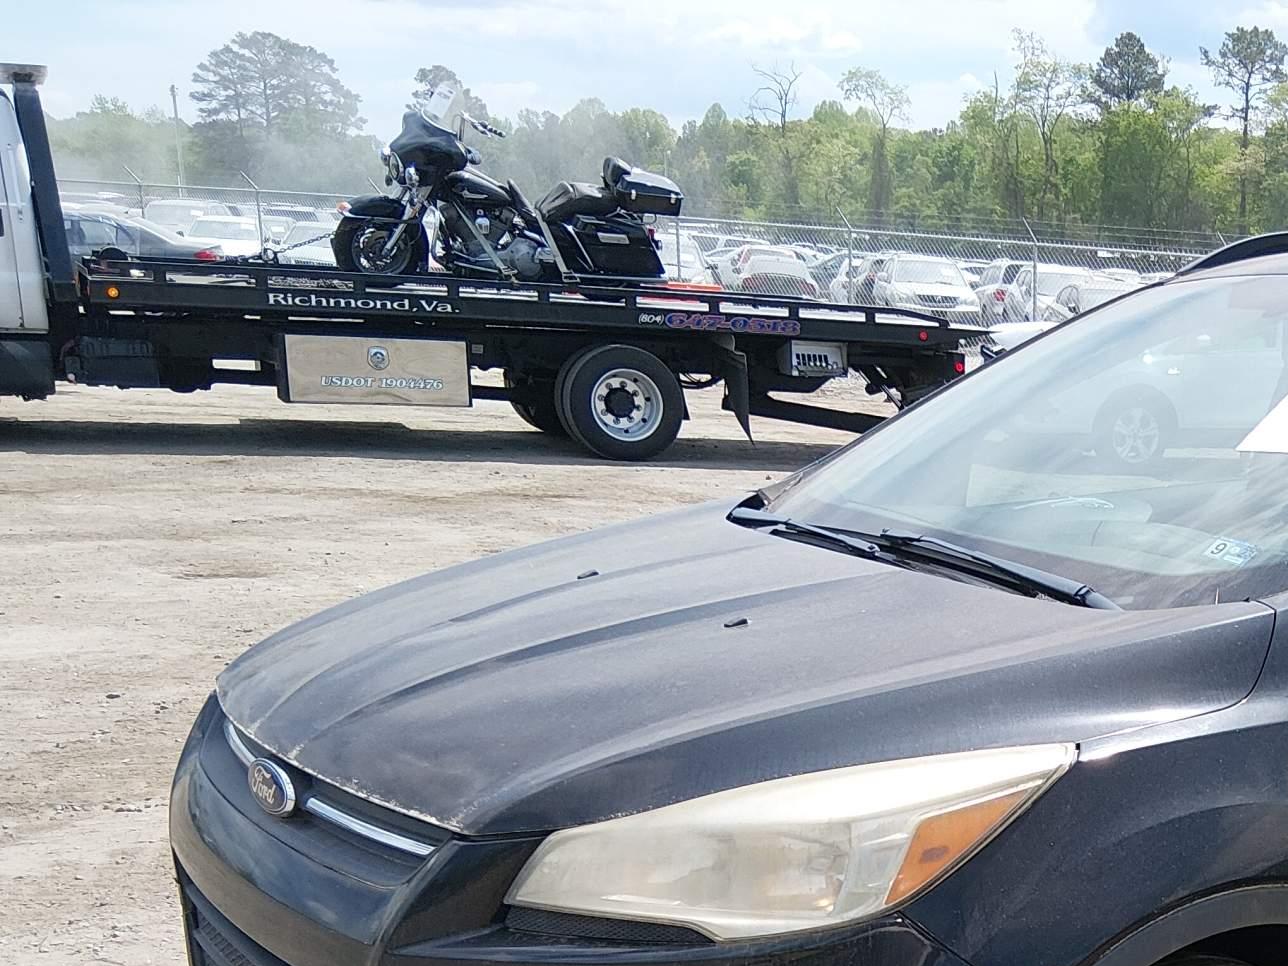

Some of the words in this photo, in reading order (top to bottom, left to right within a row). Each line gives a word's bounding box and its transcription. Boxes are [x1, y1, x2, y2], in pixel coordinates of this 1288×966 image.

[638, 312, 665, 325] (804)
[320, 376, 375, 388] USDOT
[379, 377, 444, 390] 1904476
[251, 765, 275, 804] Ford
